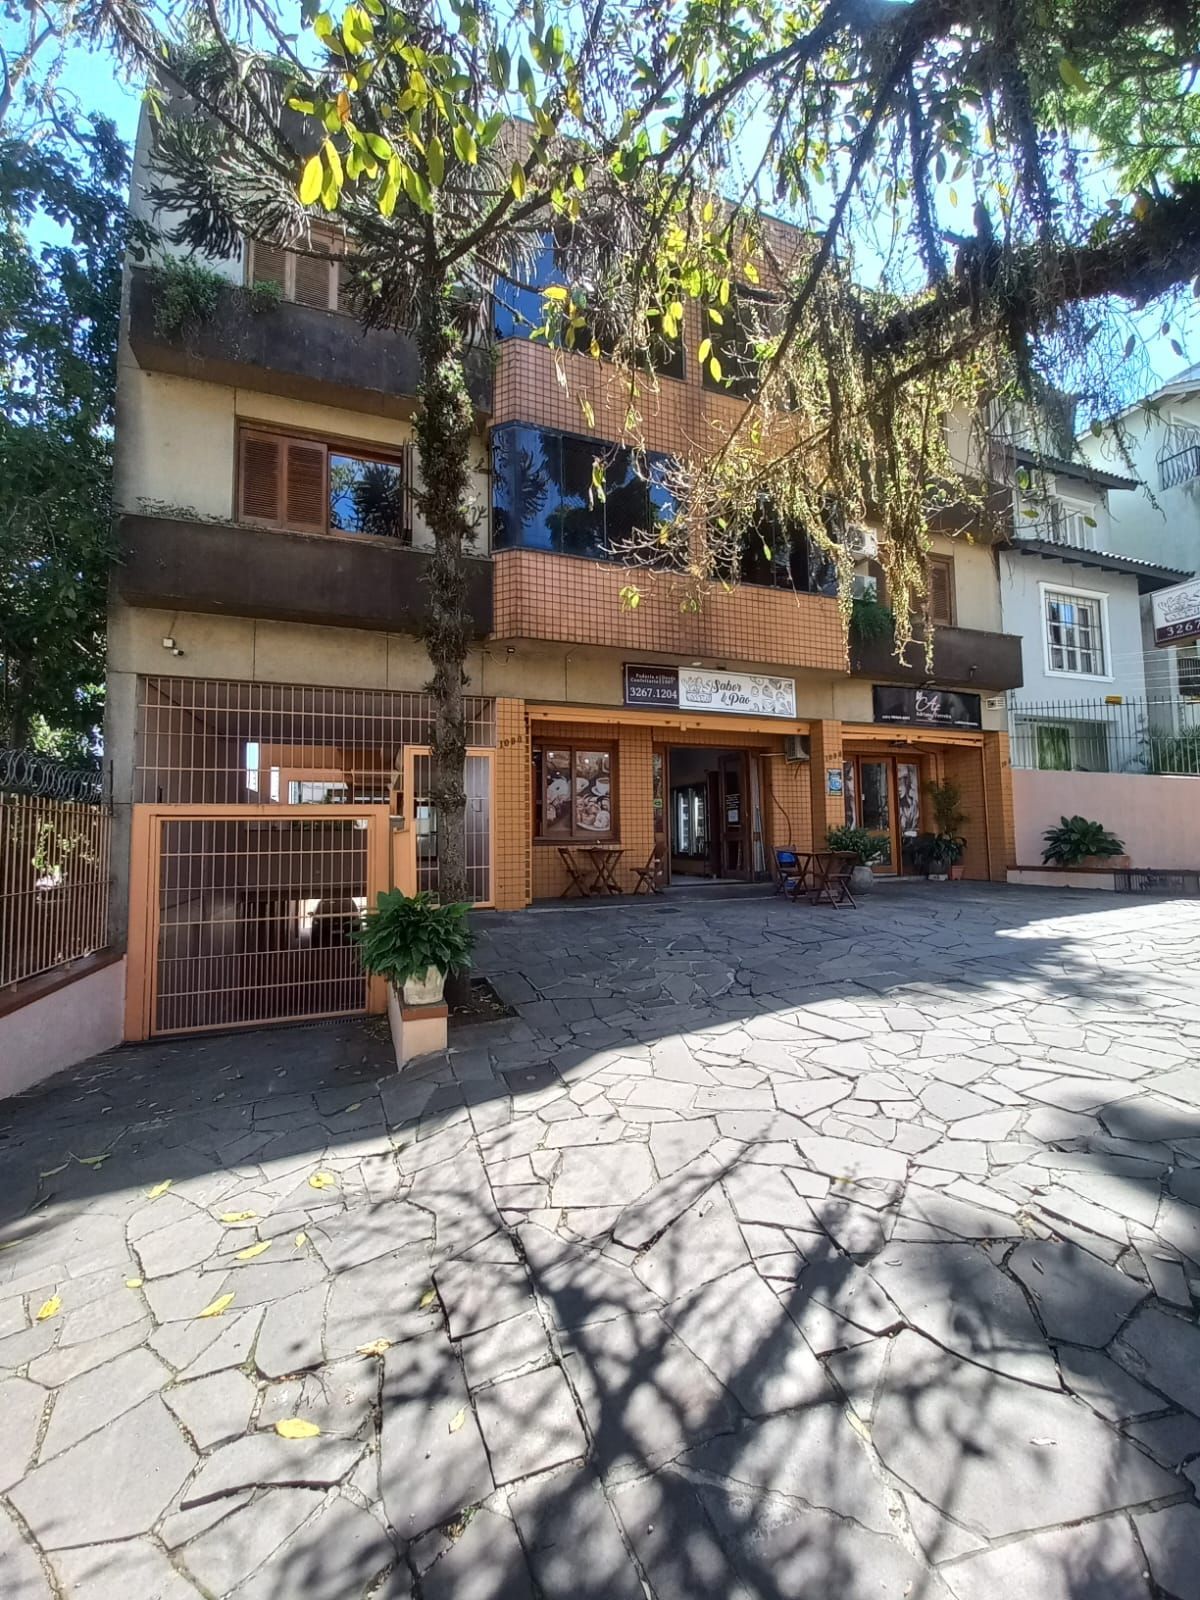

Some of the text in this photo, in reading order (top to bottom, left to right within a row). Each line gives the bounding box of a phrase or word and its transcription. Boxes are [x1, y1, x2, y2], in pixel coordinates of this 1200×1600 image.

[711, 679, 742, 693] Sabor
[629, 687, 677, 699] 3267.1204
[728, 693, 751, 706] Pão
